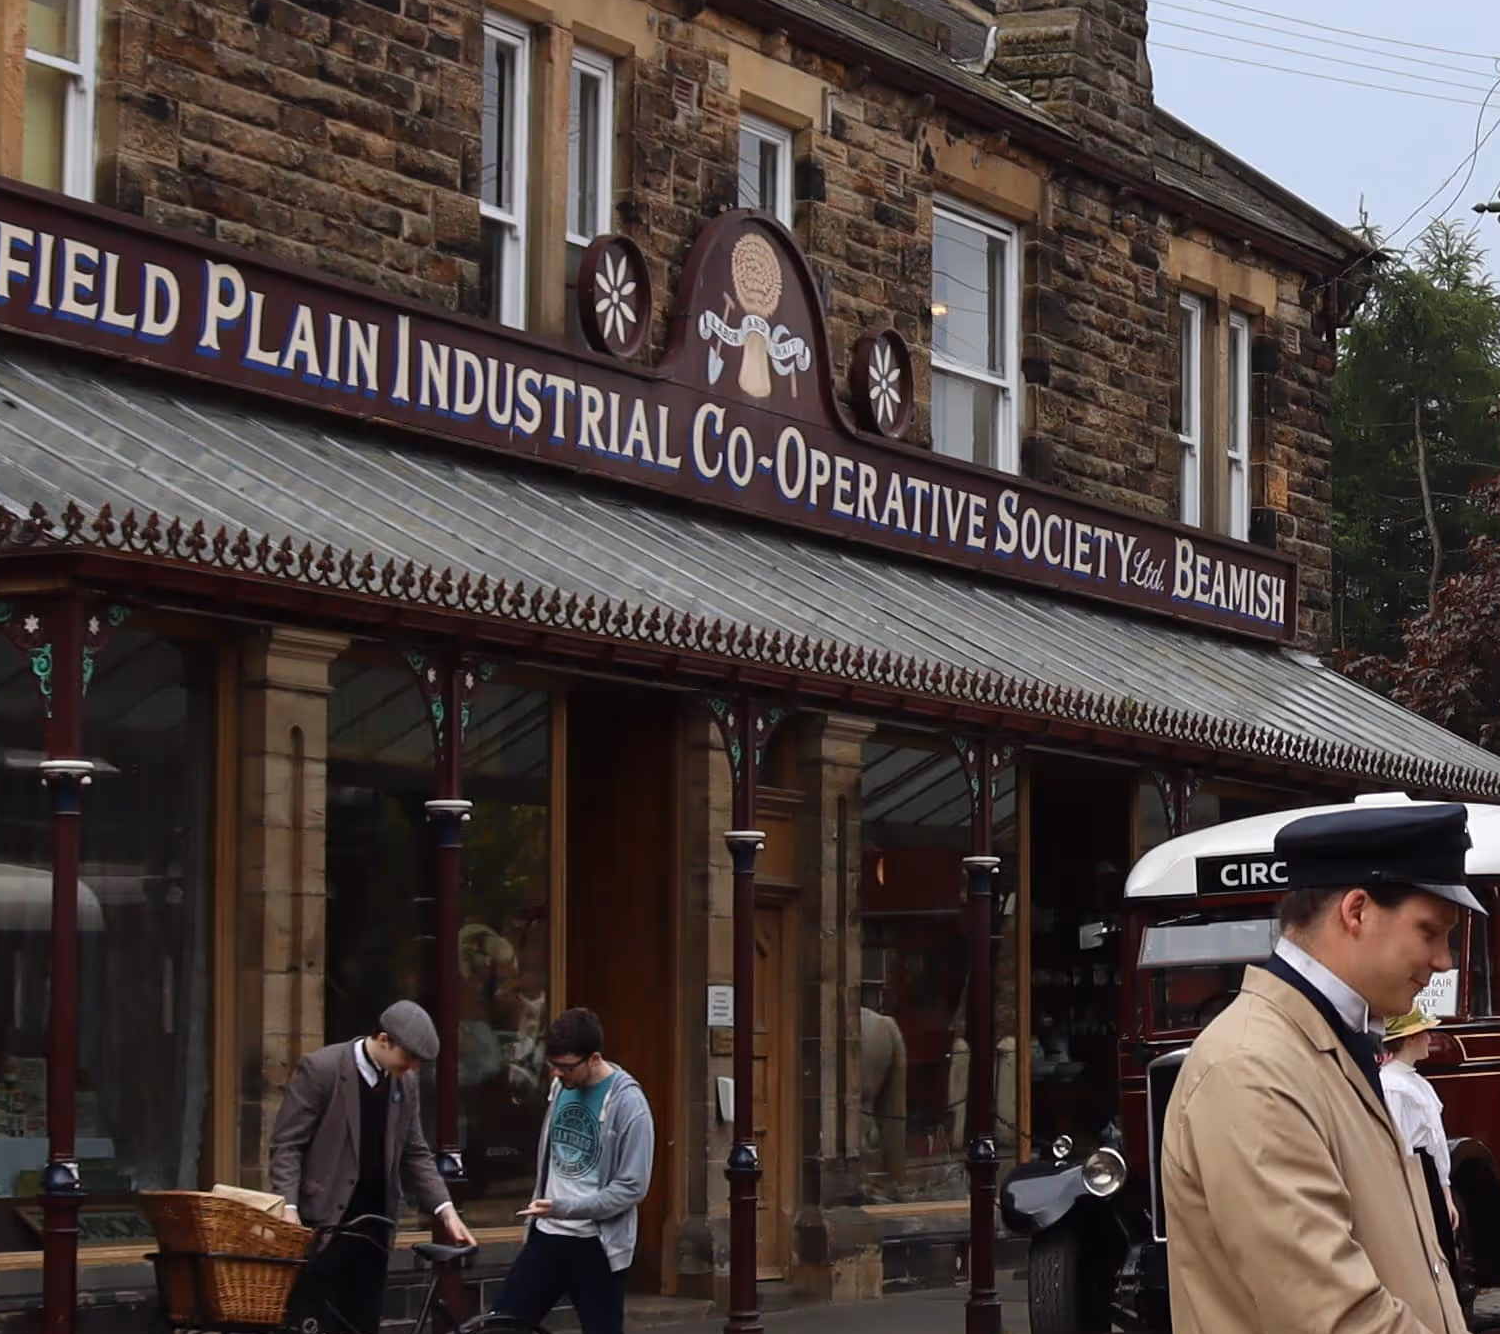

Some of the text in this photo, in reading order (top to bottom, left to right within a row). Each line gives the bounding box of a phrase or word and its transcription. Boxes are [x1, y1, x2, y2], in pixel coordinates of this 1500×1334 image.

[197, 259, 381, 398] PLAIN
[390, 314, 682, 474] INDUSTRIAL
[994, 489, 1137, 585] SOCIETY
[1130, 547, 1167, 593] Ltd.
[1170, 536, 1286, 627] BEAMISH
[774, 343, 797, 357] WAIT
